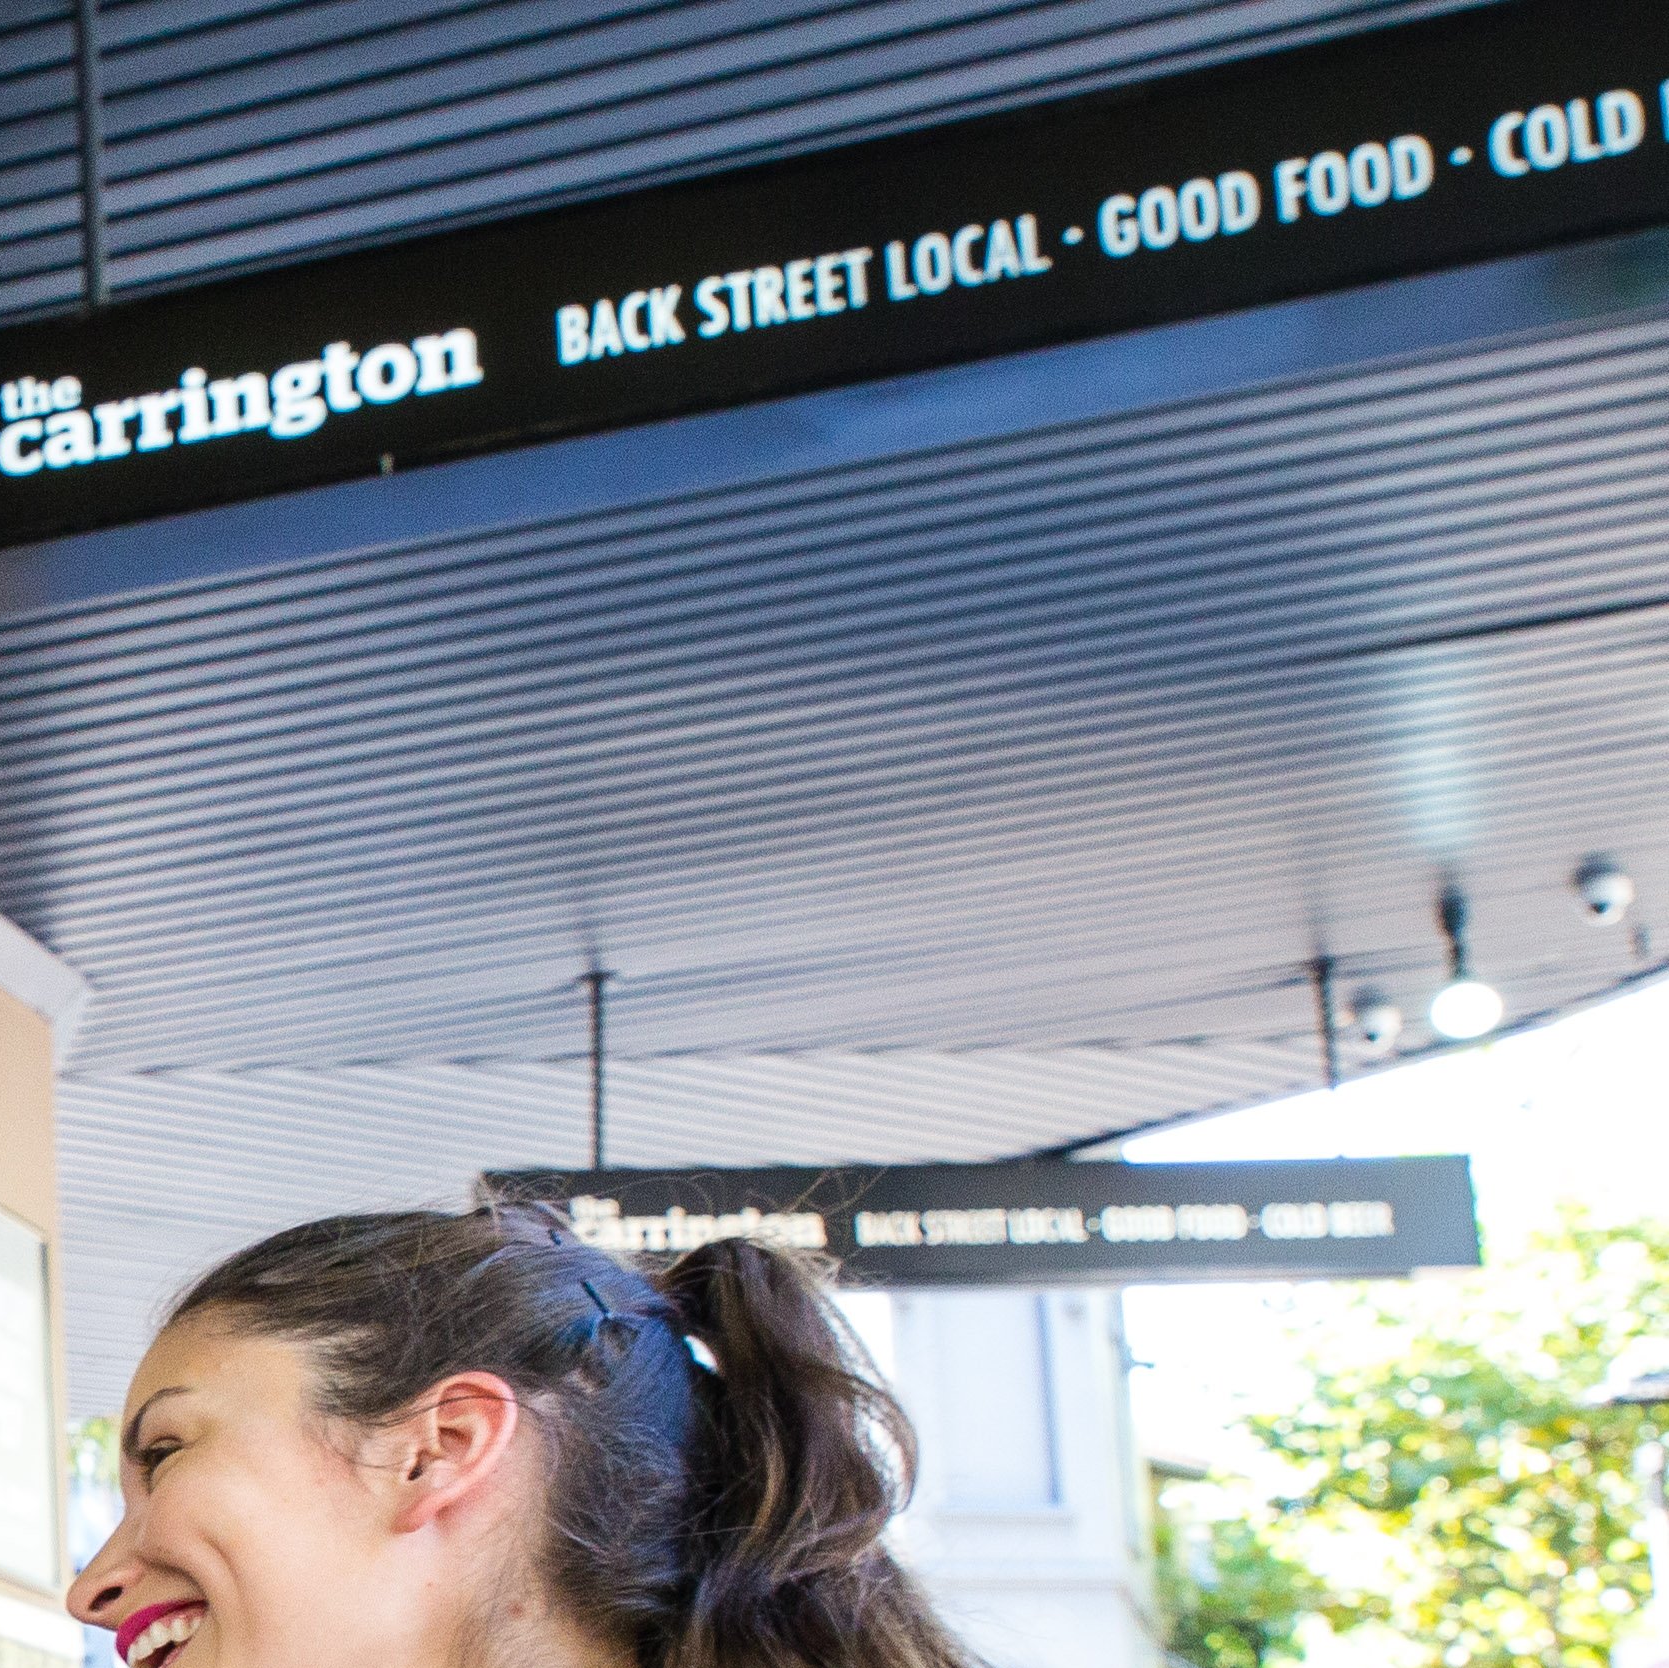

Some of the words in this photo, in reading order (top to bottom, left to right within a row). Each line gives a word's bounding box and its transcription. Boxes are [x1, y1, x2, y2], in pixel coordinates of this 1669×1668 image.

[557, 284, 685, 365] BACK
[695, 248, 873, 337] STREET
[885, 213, 1052, 301] LOCAL
[1099, 170, 1261, 257] GOOD
[1276, 135, 1434, 222] FOOD
[1490, 89, 1645, 177] COLD
[0, 375, 83, 422] the
